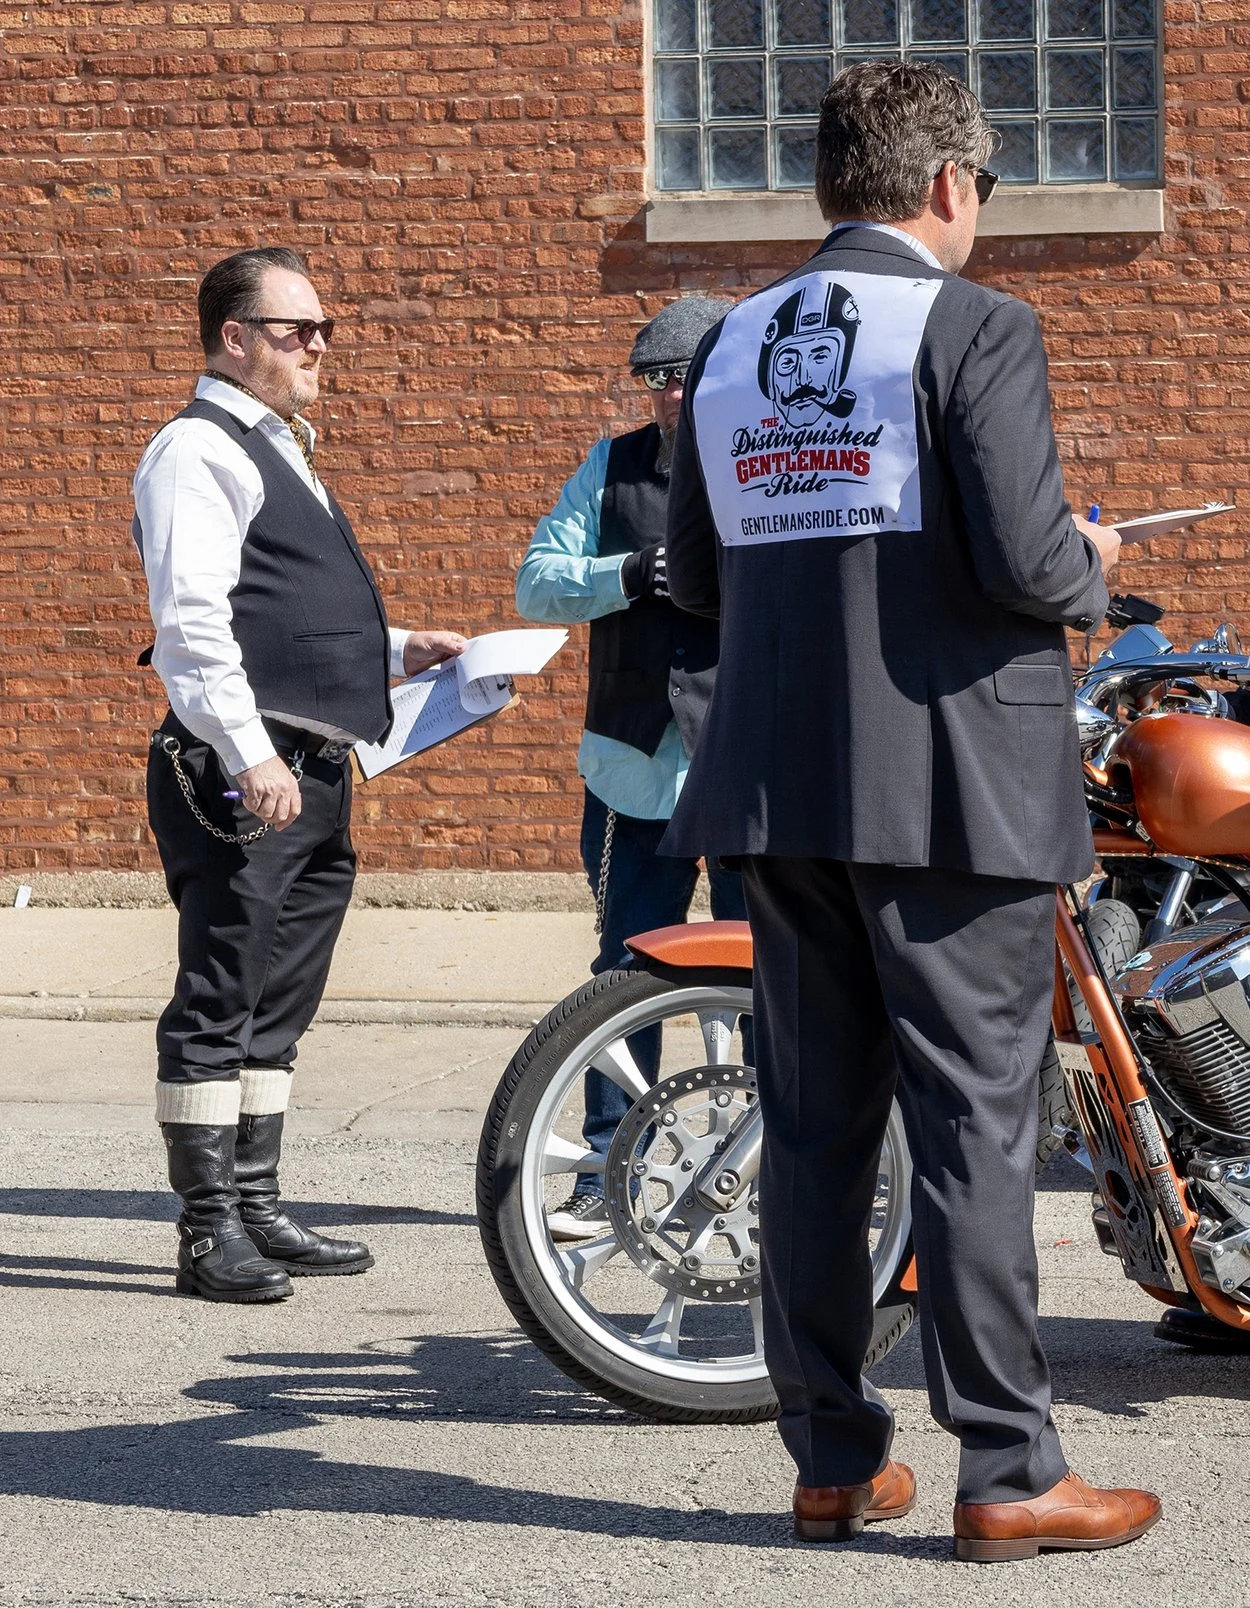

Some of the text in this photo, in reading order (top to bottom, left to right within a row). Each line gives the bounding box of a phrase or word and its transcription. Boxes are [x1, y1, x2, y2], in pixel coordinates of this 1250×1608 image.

[760, 417, 780, 428] THE
[731, 421, 884, 457] Distinguished
[764, 472, 829, 498] Ride
[741, 507, 884, 535] GENTLEMANSRIDE.COM
